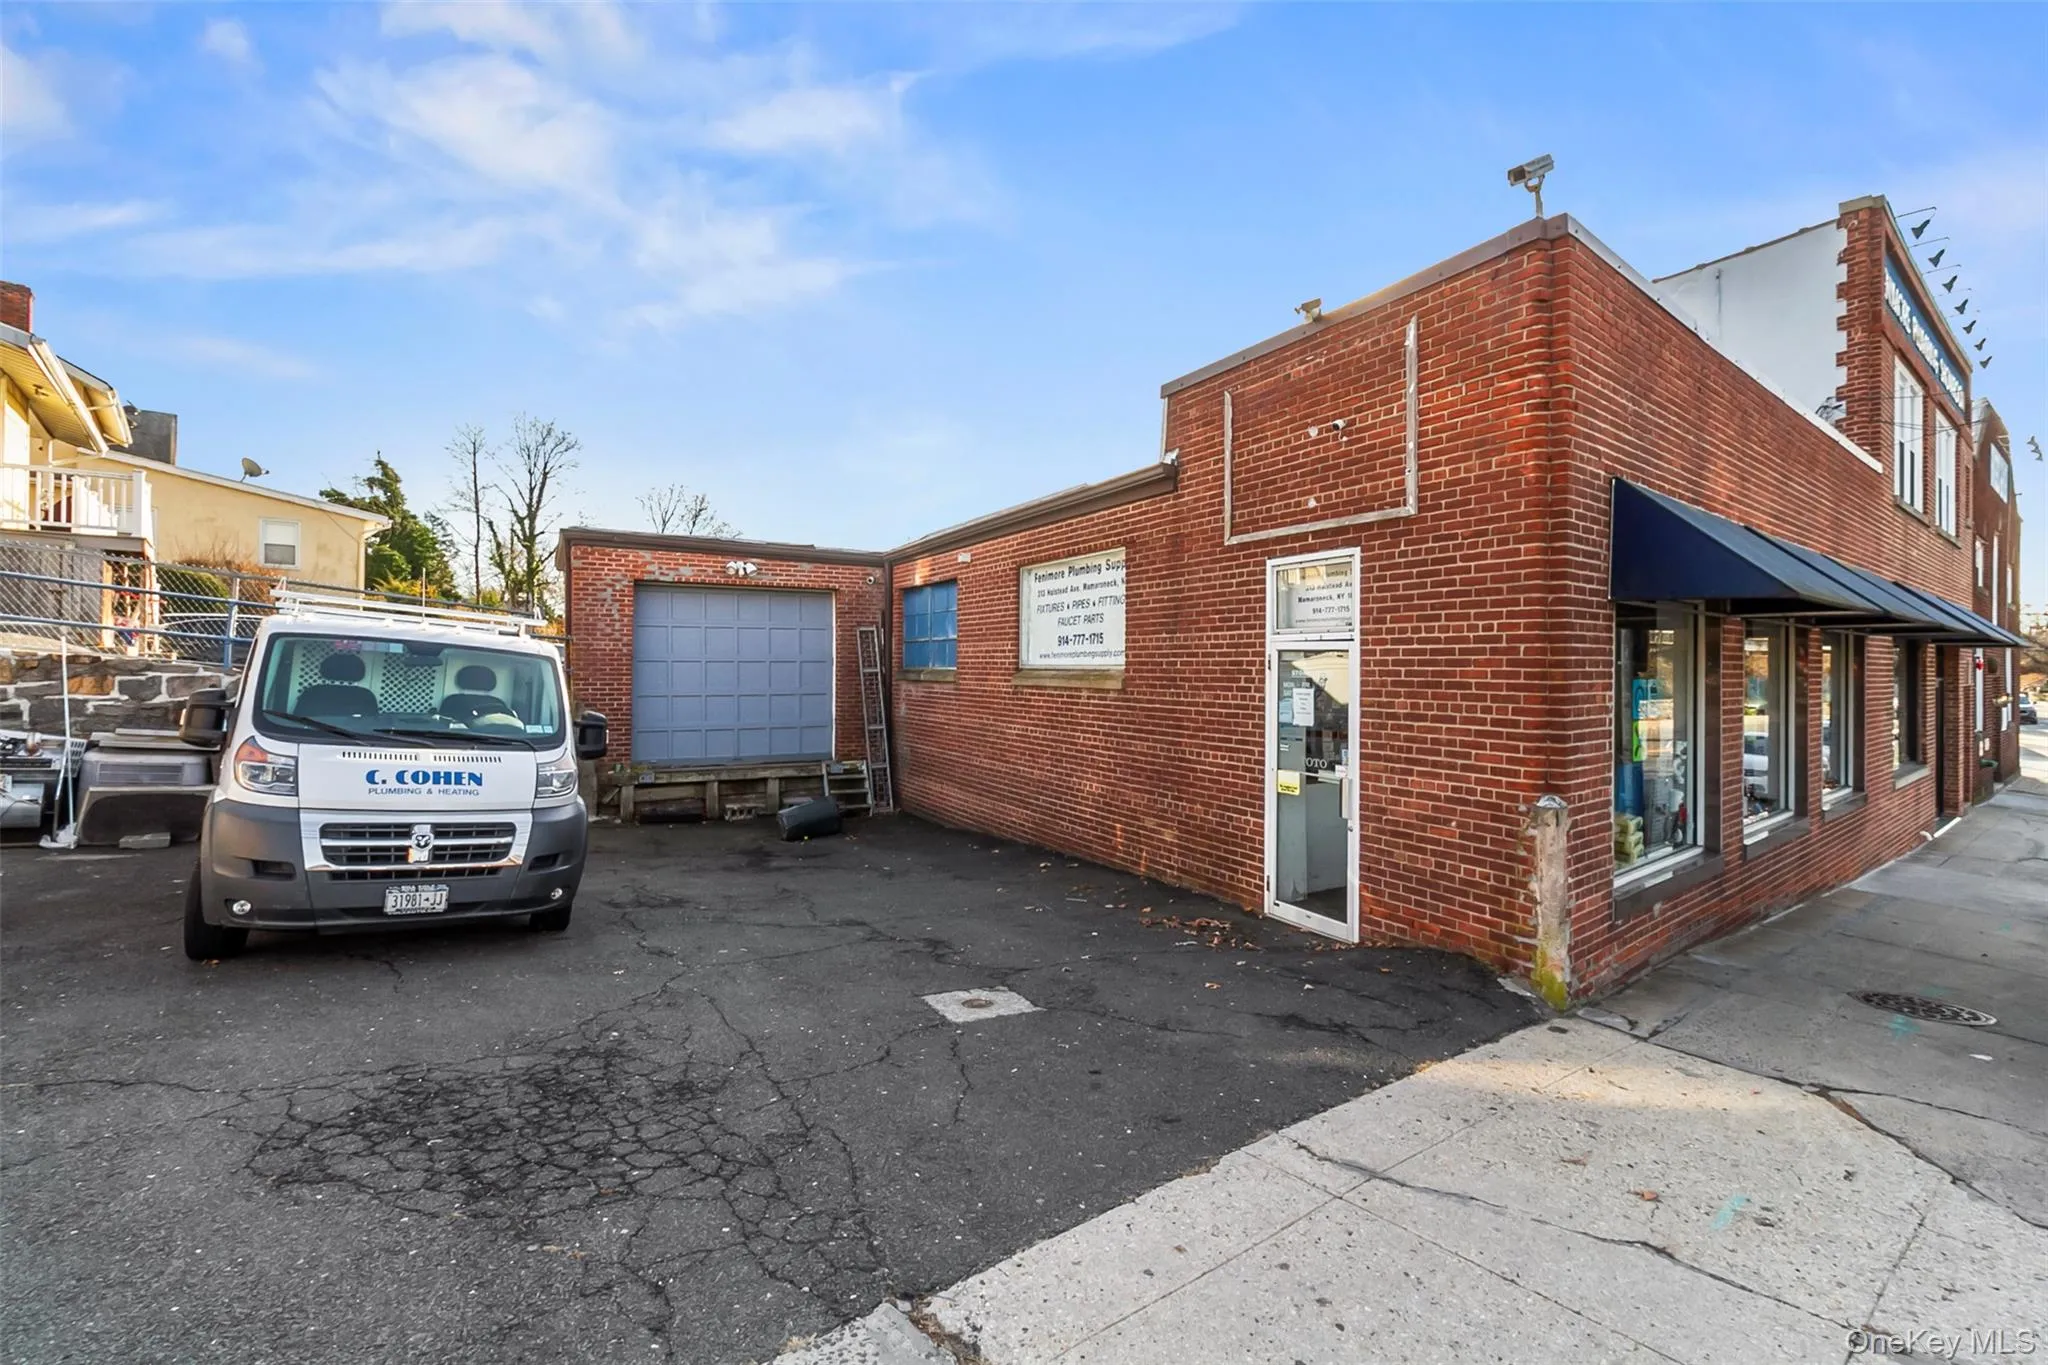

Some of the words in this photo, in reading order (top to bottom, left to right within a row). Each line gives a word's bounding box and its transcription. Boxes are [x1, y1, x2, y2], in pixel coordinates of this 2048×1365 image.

[1034, 570, 1065, 583] Fenimore
[1068, 563, 1102, 577] Plumbing
[1036, 602, 1065, 614] FIXTURES
[1072, 598, 1090, 609] PIPES
[1312, 605, 1351, 614] 914-777-1715
[1057, 615, 1081, 626] FAUCET
[1083, 613, 1104, 624] PARTS
[1057, 633, 1104, 646] 914-777-1715
[1305, 757, 1328, 769] OTO
[365, 769, 387, 785] C.
[395, 769, 483, 787] COHEN
[368, 787, 422, 795] PLUMBING
[426, 787, 433, 795] &
[438, 788, 480, 796] HEATING
